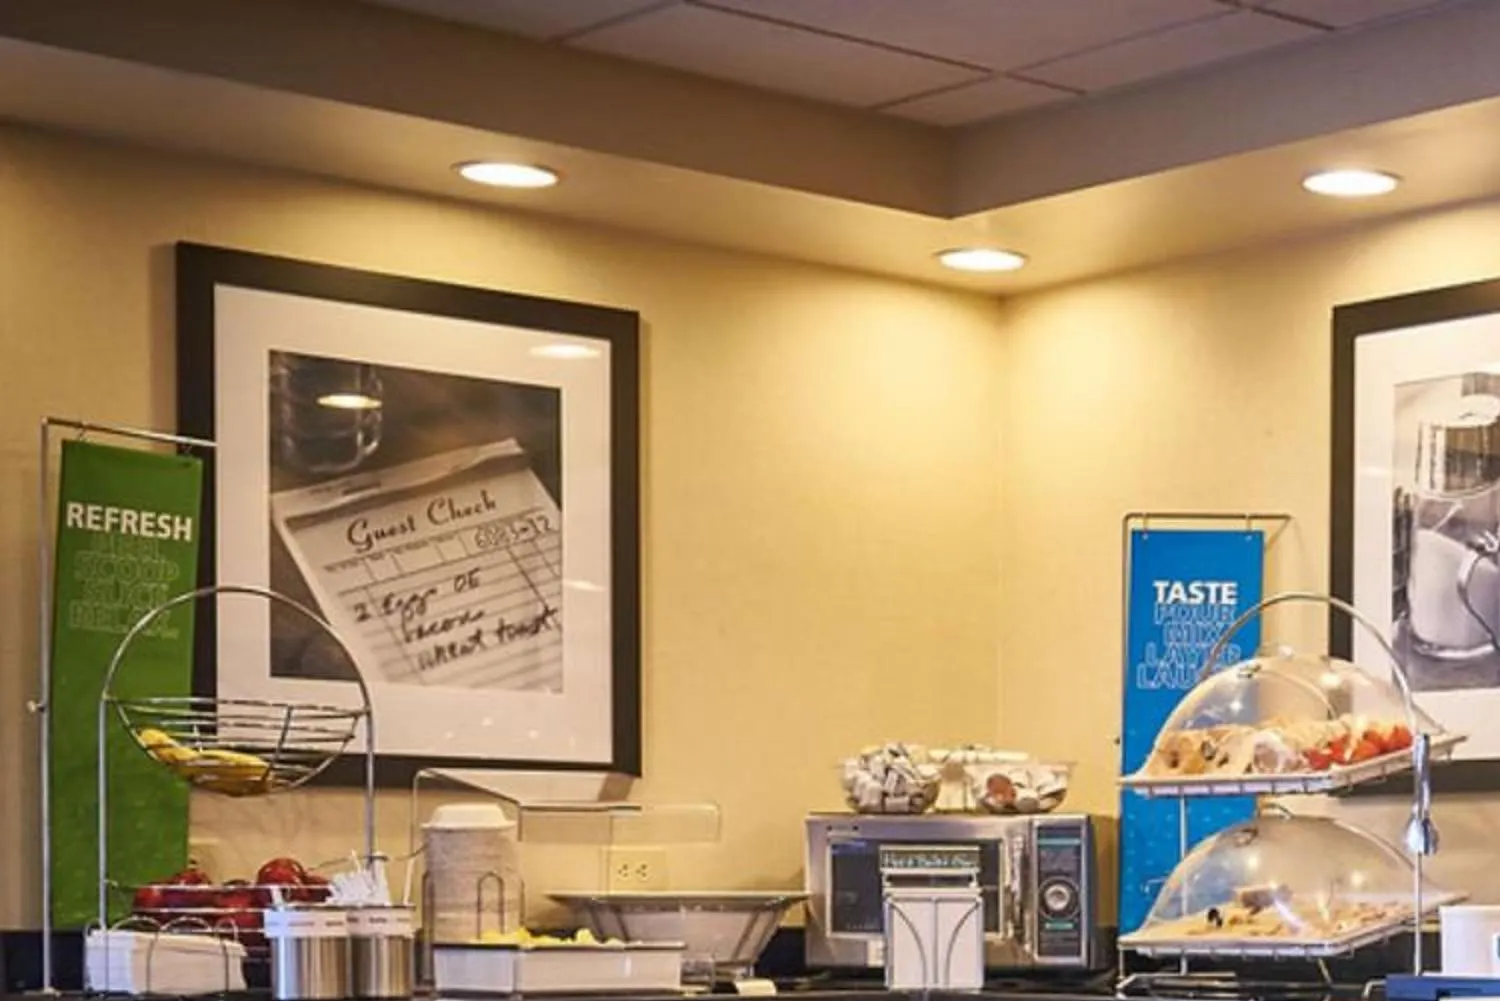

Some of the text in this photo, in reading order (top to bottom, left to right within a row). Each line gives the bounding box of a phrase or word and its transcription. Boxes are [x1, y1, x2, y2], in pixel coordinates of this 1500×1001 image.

[66, 501, 193, 542] REFRESH
[346, 516, 415, 553] Guest
[426, 489, 496, 525] Check
[1152, 580, 1238, 605] TASTE
[354, 602, 371, 623] 2
